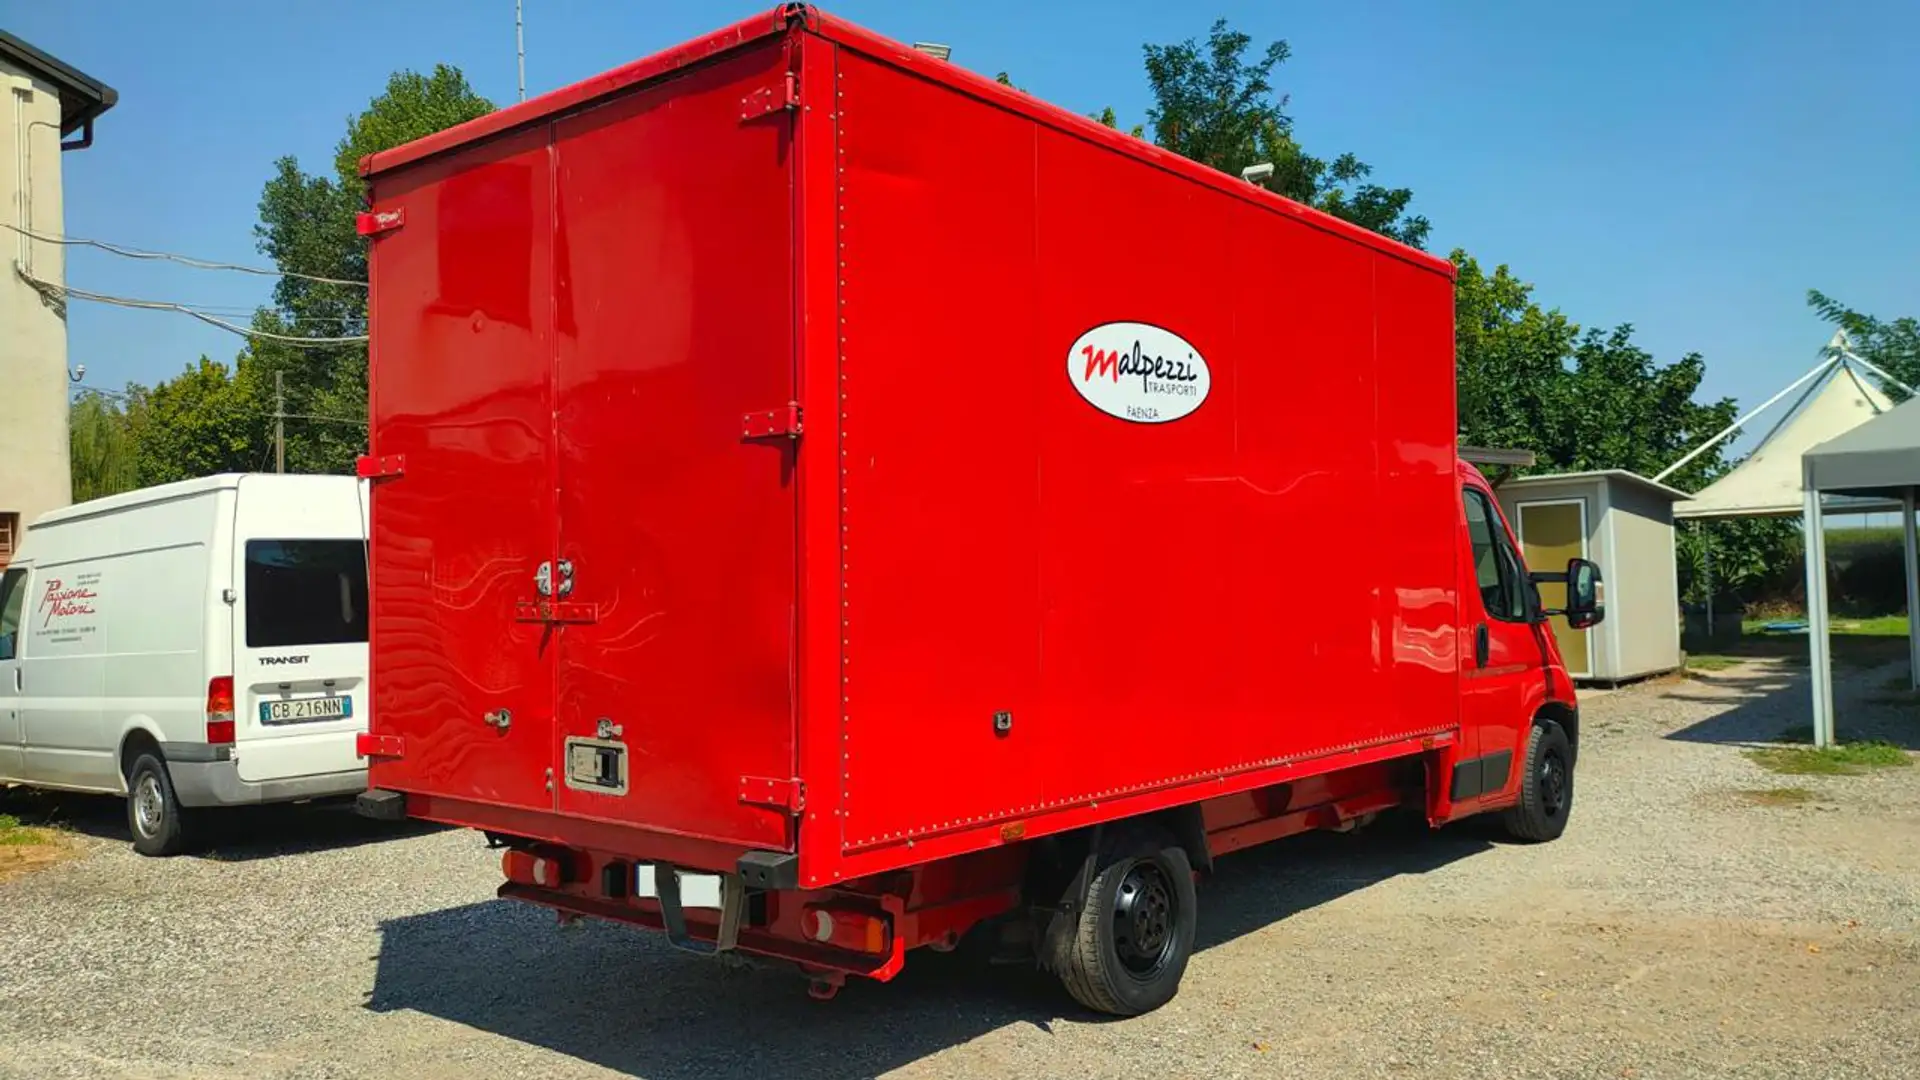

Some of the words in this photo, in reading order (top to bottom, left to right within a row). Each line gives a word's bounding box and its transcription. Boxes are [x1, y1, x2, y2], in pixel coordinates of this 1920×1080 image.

[1082, 339, 1197, 394] Malpezzi
[1149, 381, 1197, 397] TRASPORTI
[1127, 405, 1159, 419] FAENZA
[259, 655, 310, 666] TRANSIT
[272, 703, 290, 718] CB
[296, 699, 341, 717] 216NN
